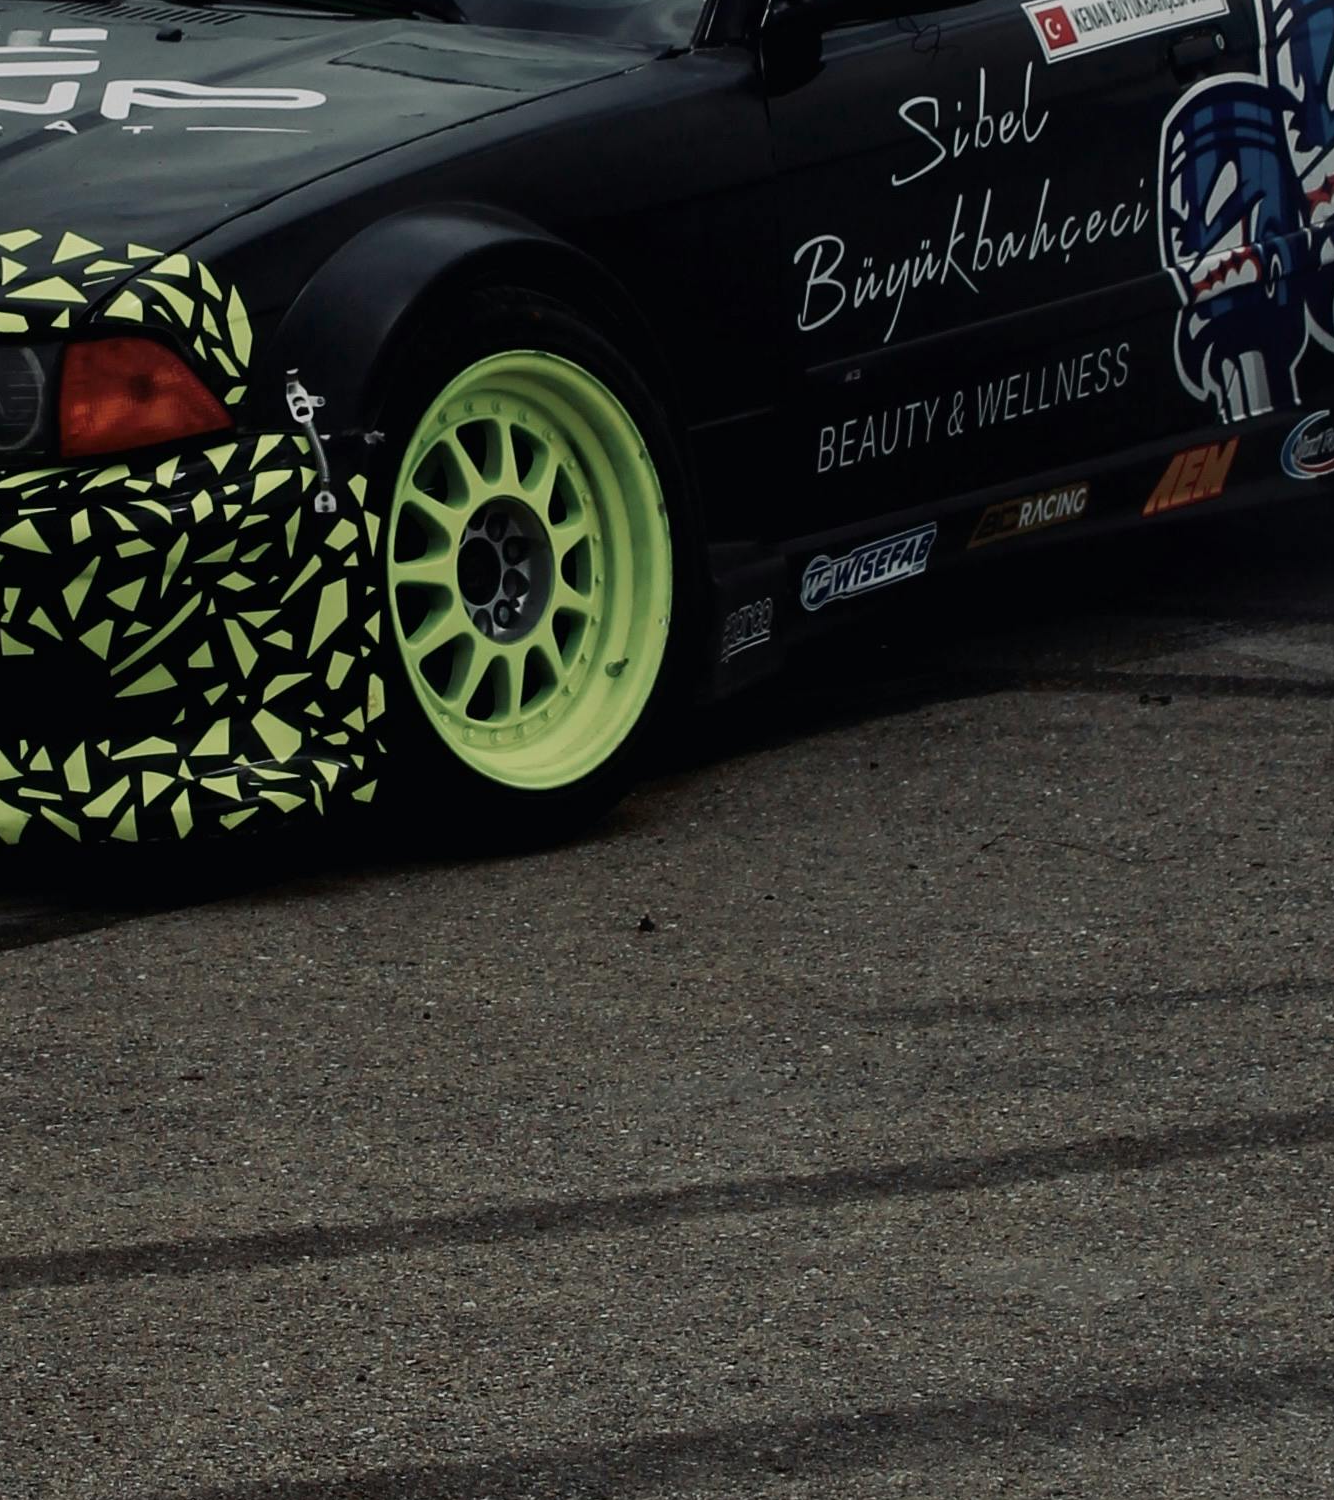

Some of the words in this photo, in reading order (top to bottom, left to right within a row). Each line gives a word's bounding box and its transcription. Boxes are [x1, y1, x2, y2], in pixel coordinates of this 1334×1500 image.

[1071, 2, 1112, 33] KENAN
[891, 61, 1050, 187] Sibel
[793, 177, 1151, 344] Büyükbahçeci
[816, 395, 941, 473] BEAUTY
[946, 389, 966, 437] &
[977, 341, 1130, 428] WELLNESS
[1018, 486, 1088, 528] RACING
[1140, 434, 1241, 518] AEM
[832, 531, 936, 594] WISEFAB
